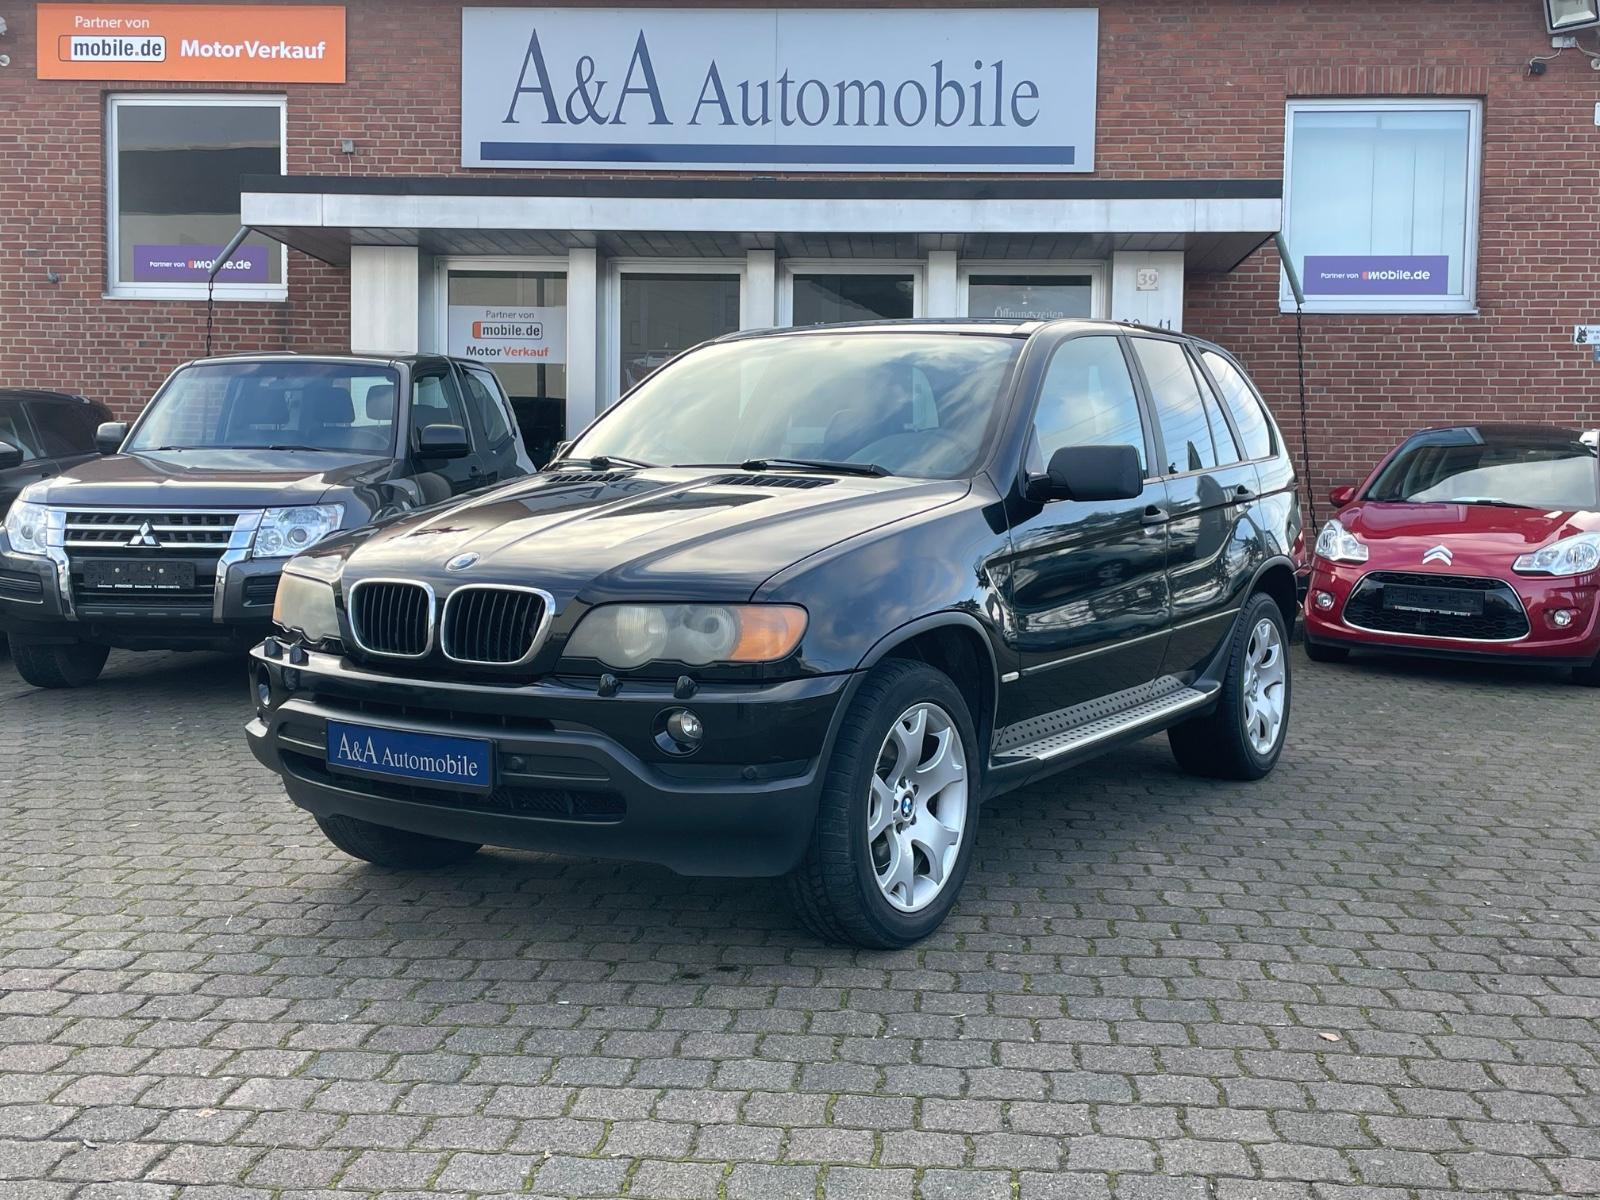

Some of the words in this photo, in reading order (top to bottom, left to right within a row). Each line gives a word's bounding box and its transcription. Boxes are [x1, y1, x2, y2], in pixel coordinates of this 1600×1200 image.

[75, 15, 122, 29] Partner
[125, 18, 150, 29] von
[73, 39, 162, 57] mobile.de
[502, 28, 674, 126] A&A
[687, 59, 1040, 128] Automobile
[149, 261, 172, 269] Partner
[193, 260, 251, 270] moe.de
[1138, 273, 1158, 286] 39
[1368, 270, 1431, 280] mobile.de
[485, 310, 517, 319] Partner
[482, 324, 540, 336] mobile.de
[337, 732, 378, 764] A&A
[381, 747, 478, 776] Automobile
